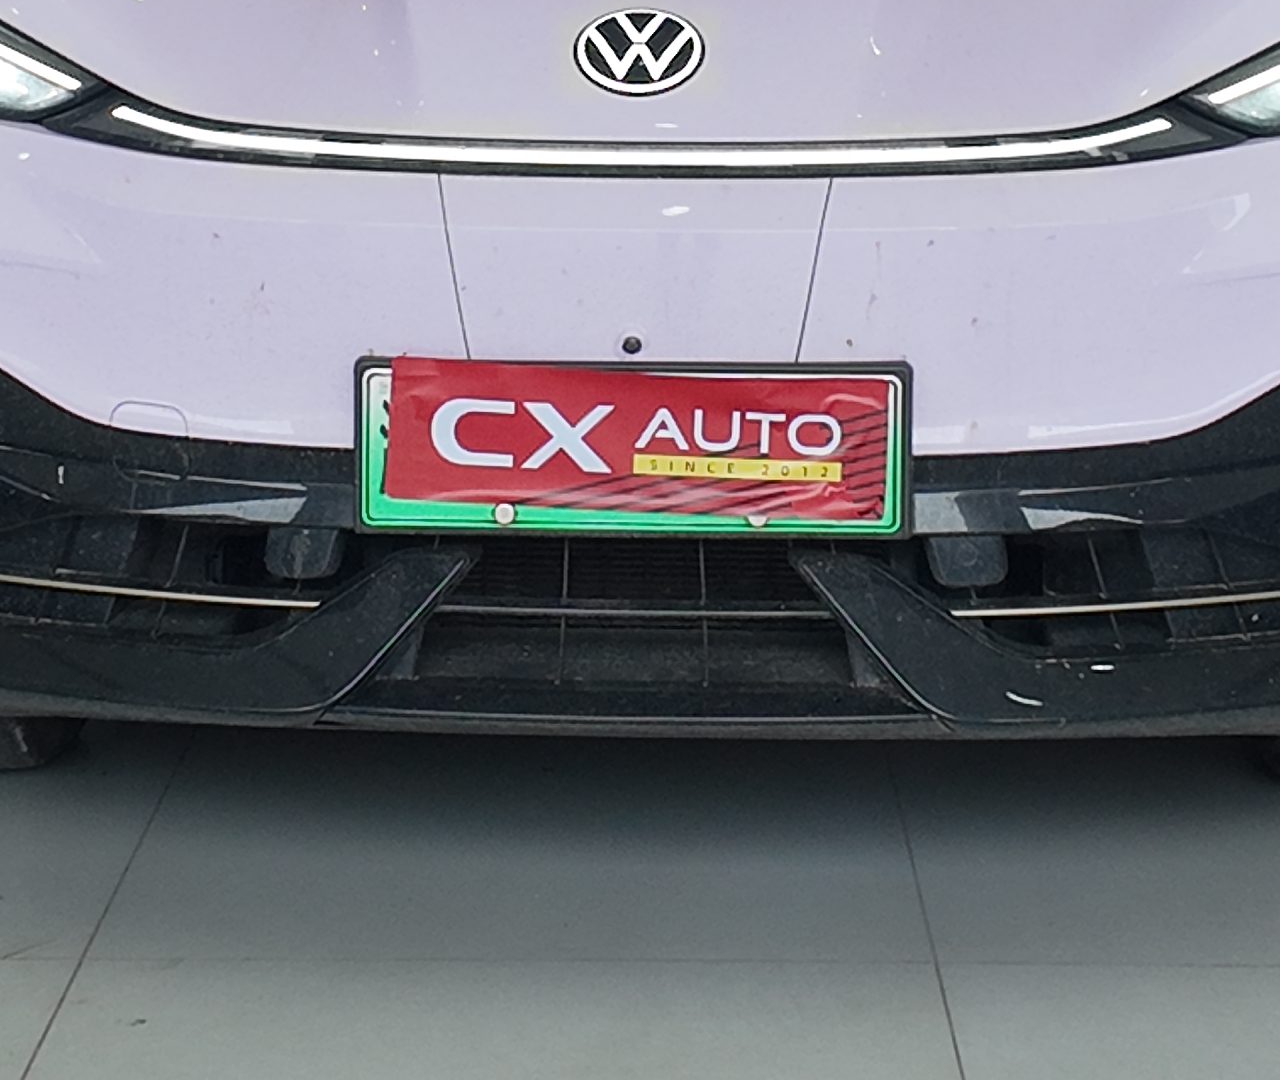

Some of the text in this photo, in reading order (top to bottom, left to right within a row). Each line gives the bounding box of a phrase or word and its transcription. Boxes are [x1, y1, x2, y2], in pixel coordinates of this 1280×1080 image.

[430, 398, 844, 474] CX AUTO
[649, 458, 829, 479] SINCE 2012
